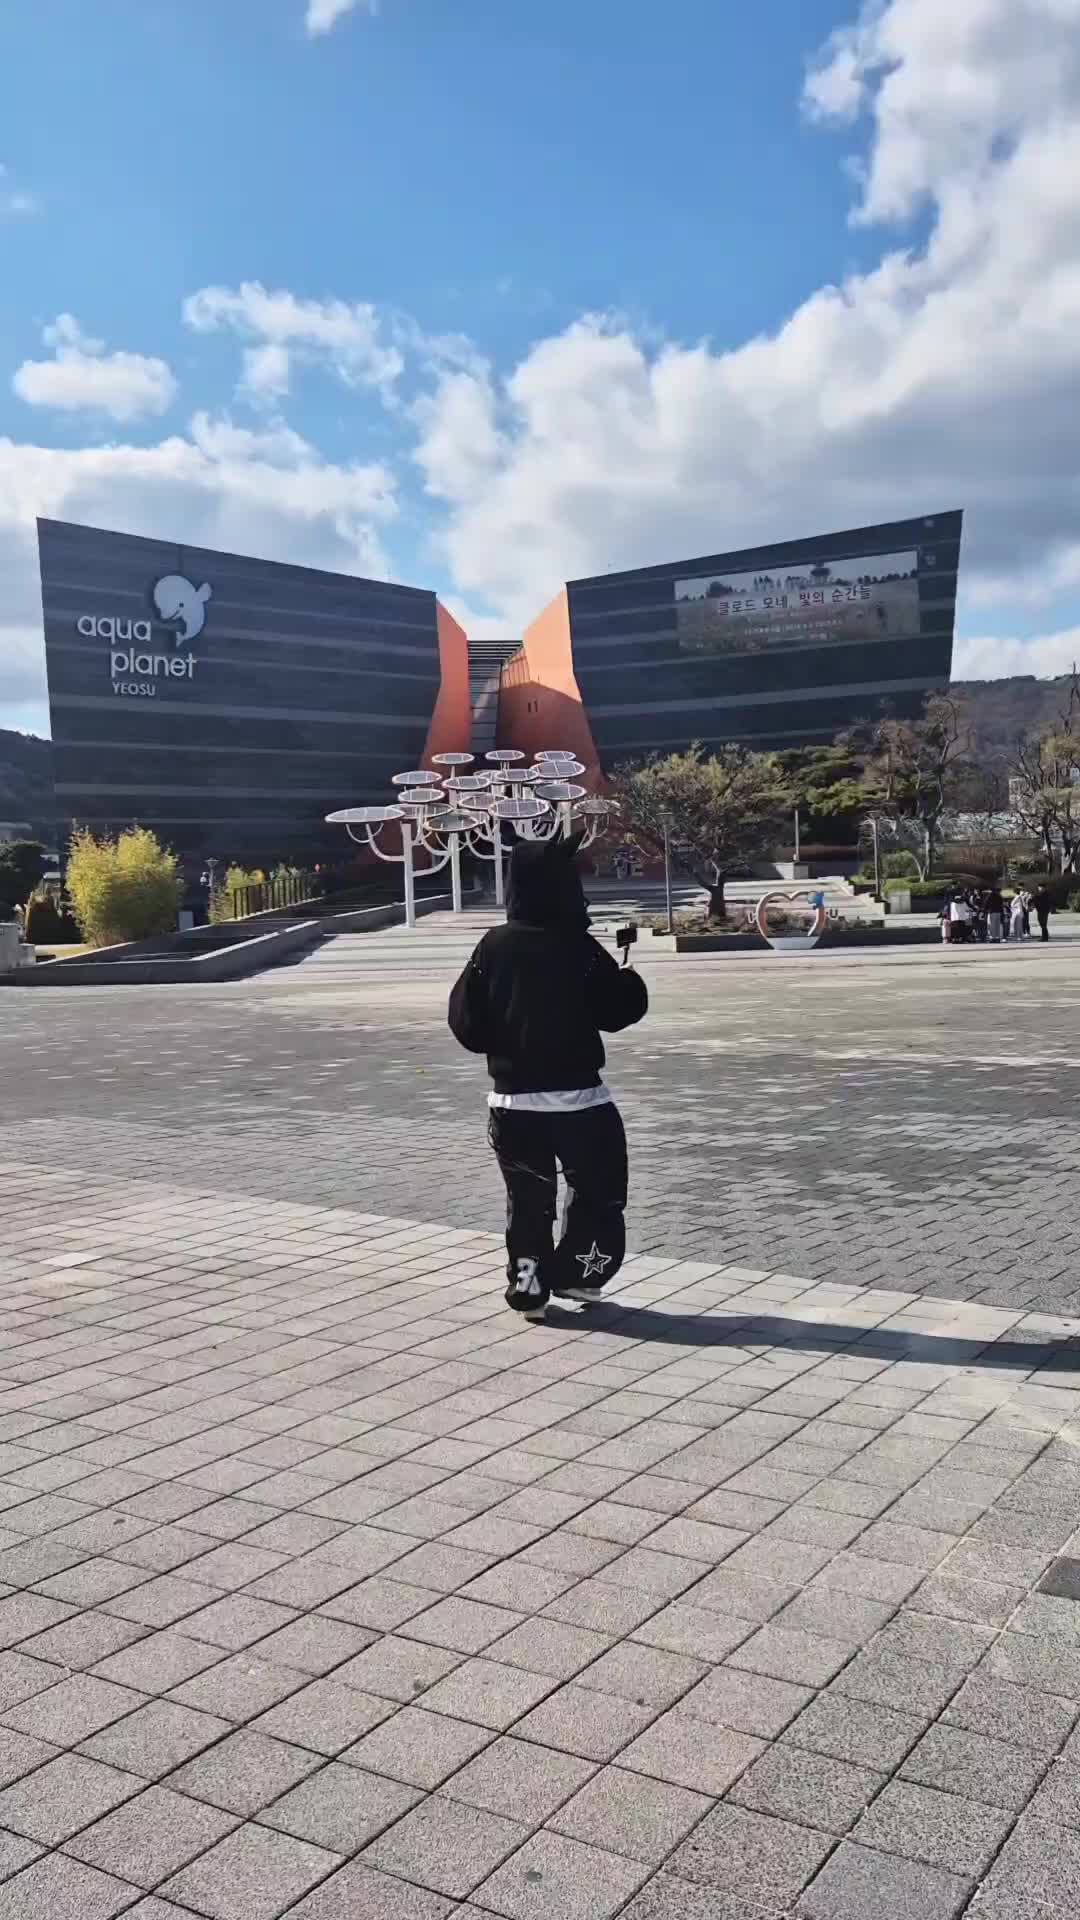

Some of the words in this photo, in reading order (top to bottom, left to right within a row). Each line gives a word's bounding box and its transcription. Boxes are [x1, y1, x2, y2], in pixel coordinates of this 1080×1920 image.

[719, 600, 757, 616] 클로드
[800, 590, 825, 607] 빛의
[831, 583, 872, 603] 순간들
[77, 614, 152, 645] aqua
[110, 647, 198, 679] planet
[111, 681, 157, 696] YEOSU
